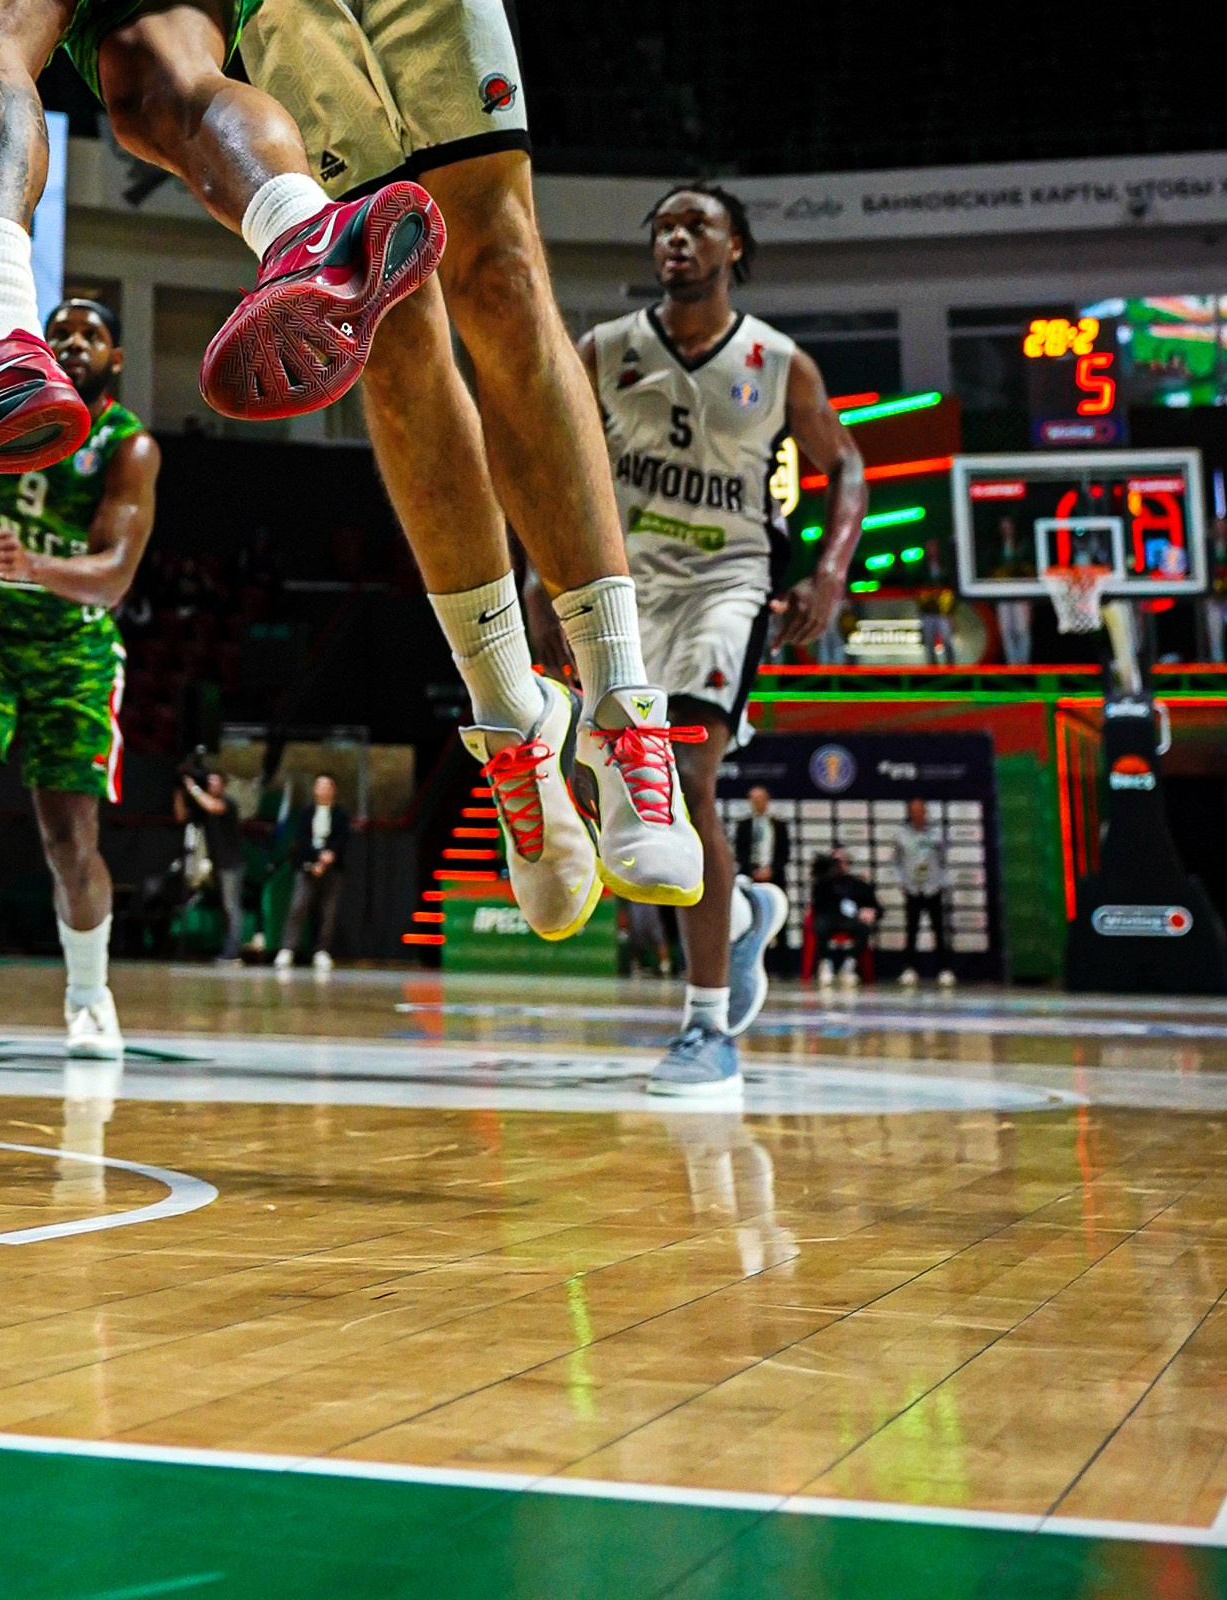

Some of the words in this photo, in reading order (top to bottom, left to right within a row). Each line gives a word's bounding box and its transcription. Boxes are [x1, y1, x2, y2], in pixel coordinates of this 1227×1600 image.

[1076, 352, 1116, 415] 5
[669, 404, 692, 450] 5
[16, 471, 50, 518] 9
[617, 452, 744, 512] AVTODOR
